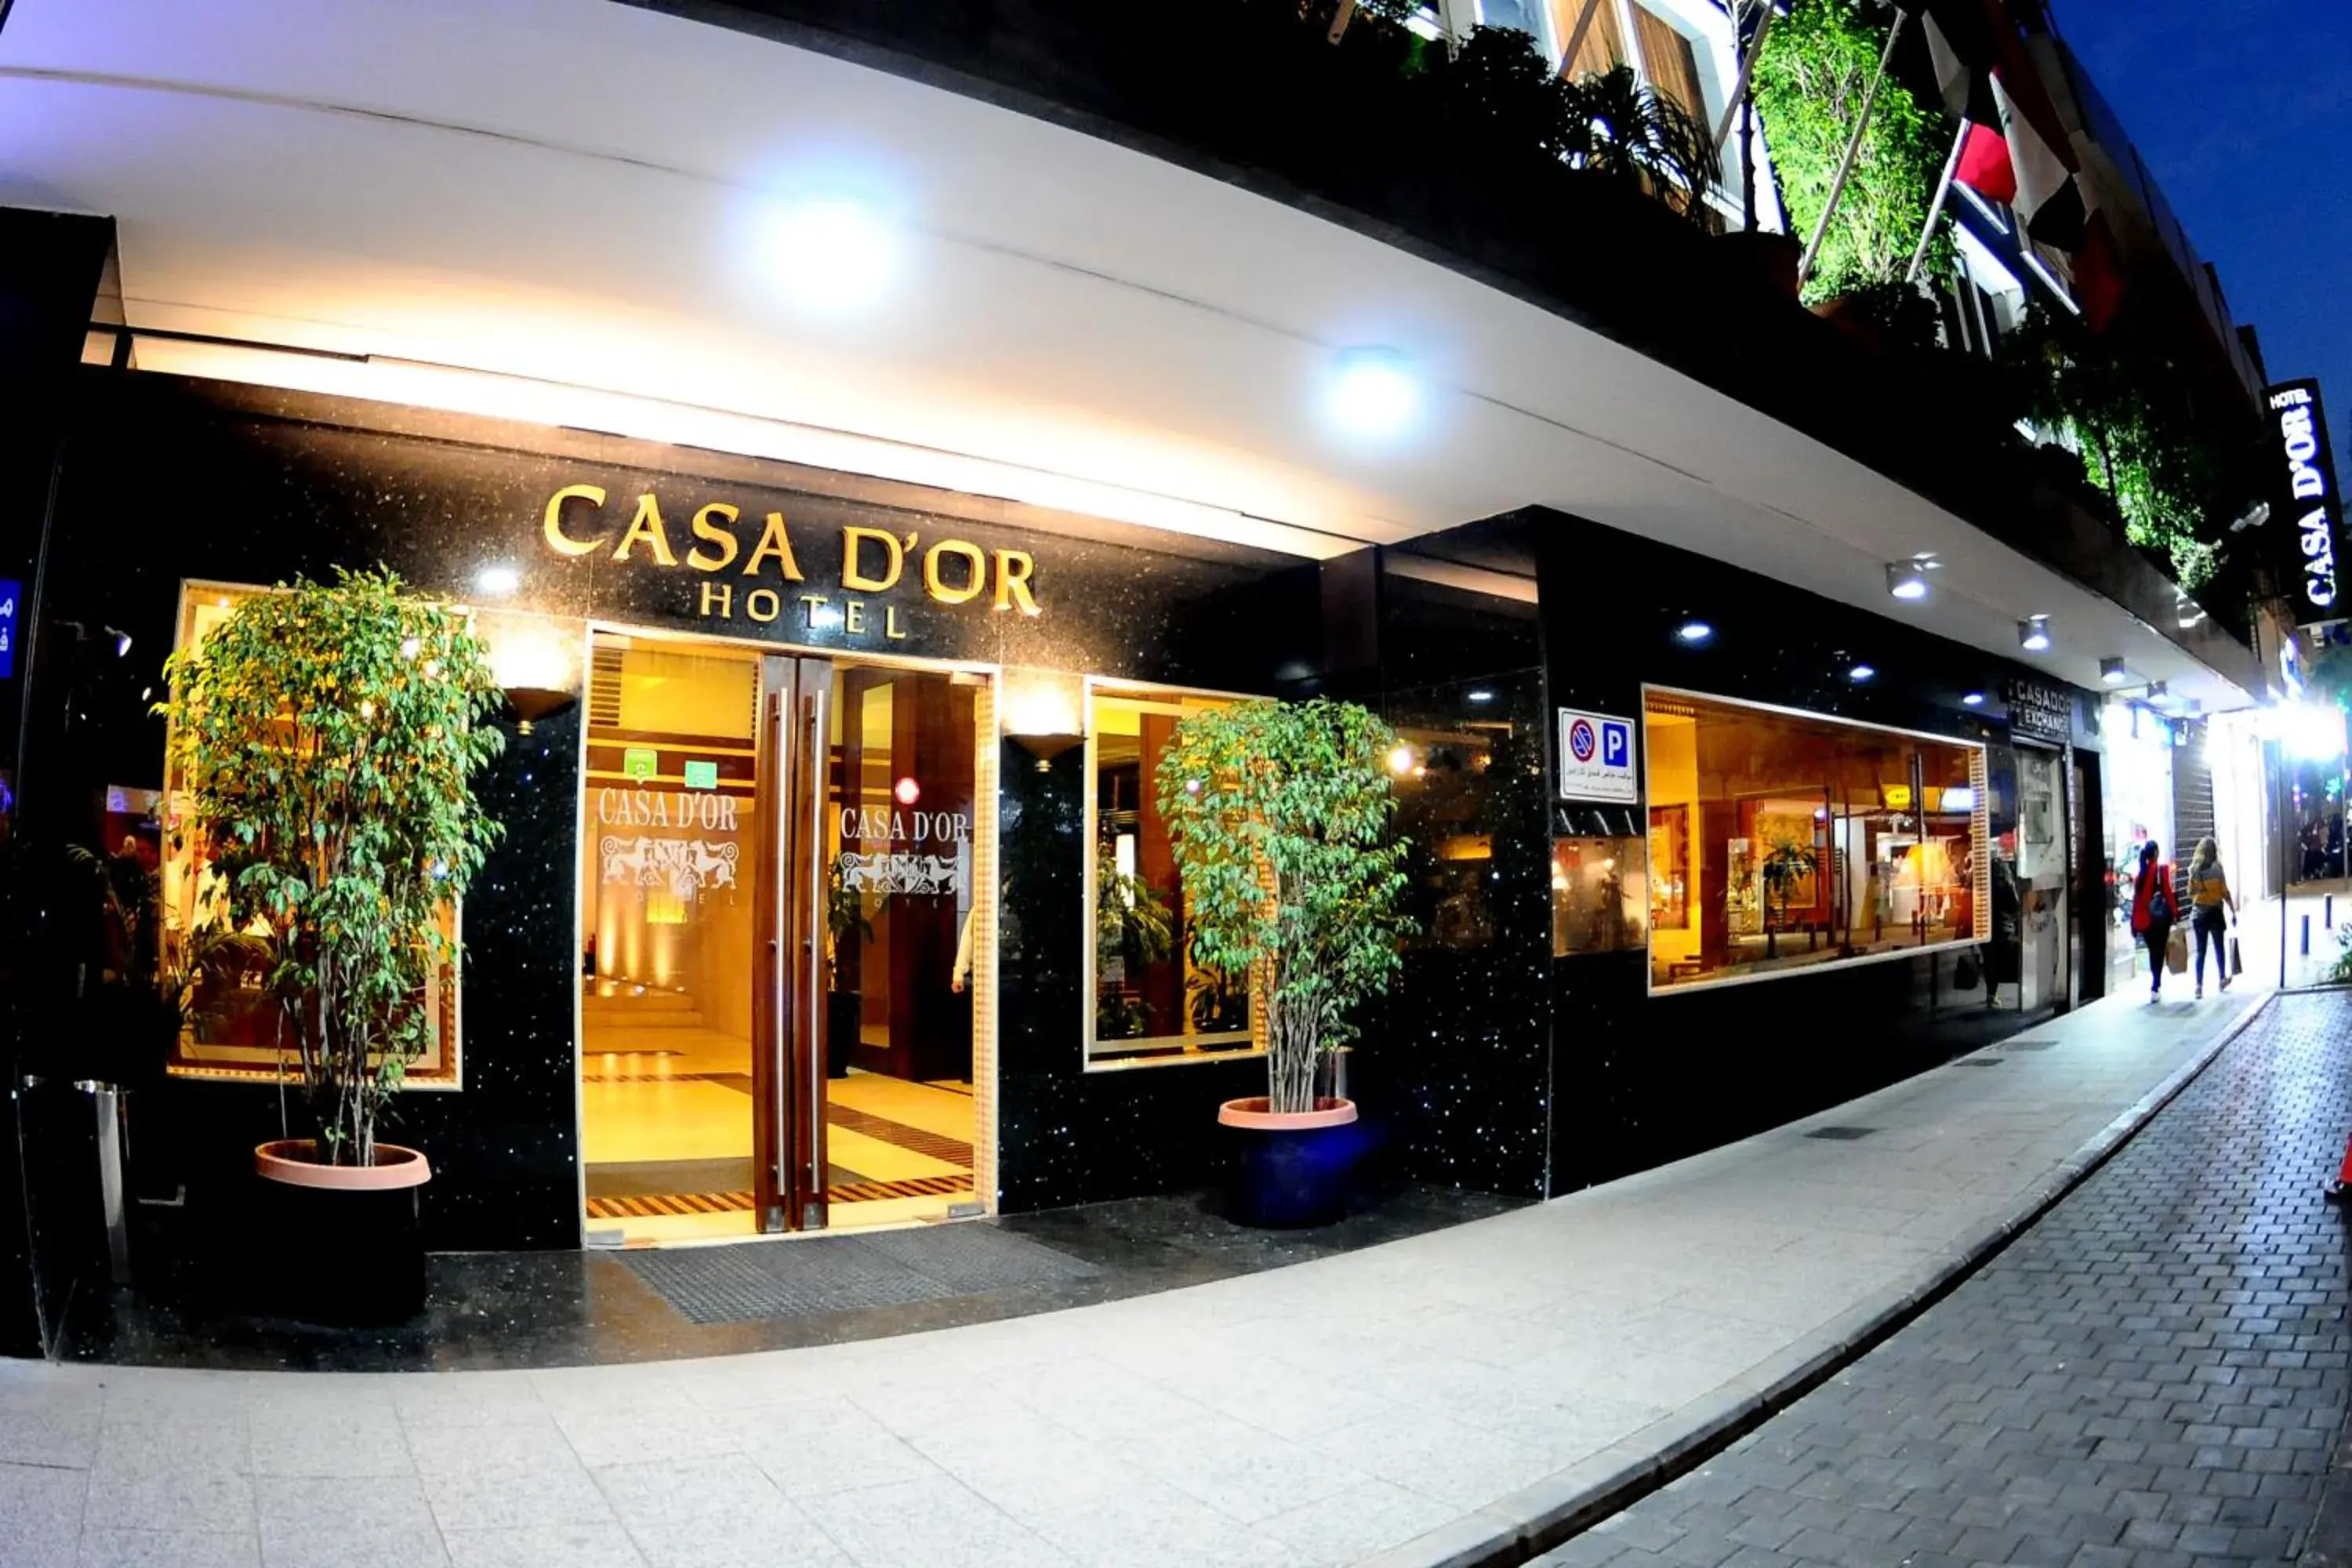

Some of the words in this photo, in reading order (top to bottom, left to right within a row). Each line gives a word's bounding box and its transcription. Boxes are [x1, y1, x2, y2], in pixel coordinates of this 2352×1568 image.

[2270, 388, 2312, 410] HOTEL
[2281, 405, 2325, 500] D'OR
[543, 484, 804, 581] CASA
[842, 525, 1043, 617] D'OR
[2297, 506, 2337, 608] CASA
[700, 582, 907, 641] HOTEL
[1608, 730, 1622, 760] P
[599, 787, 670, 827] CASA
[677, 791, 738, 831] D'OR
[841, 808, 906, 840] CASA
[913, 811, 969, 843] D'OR
